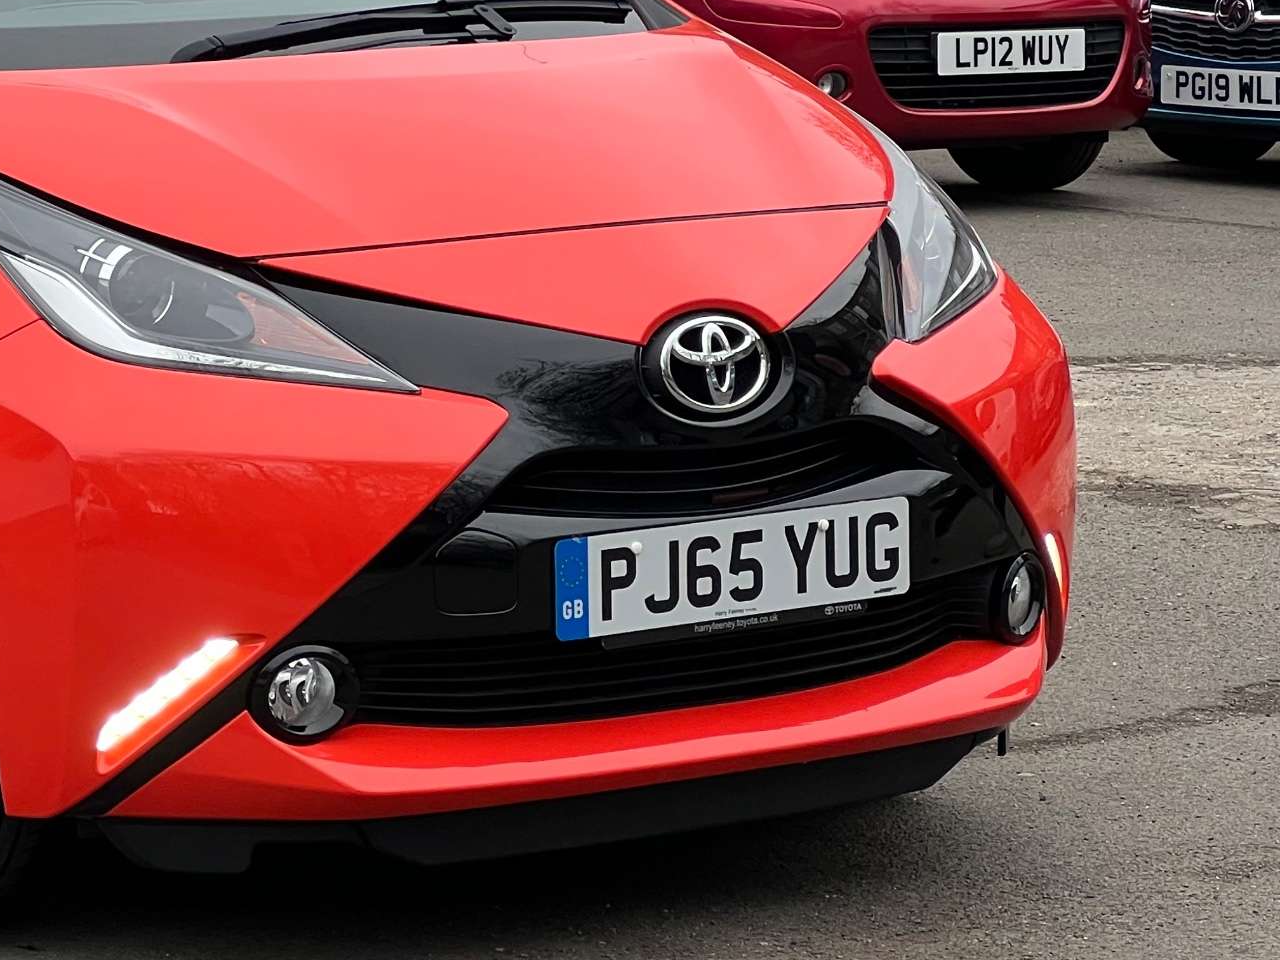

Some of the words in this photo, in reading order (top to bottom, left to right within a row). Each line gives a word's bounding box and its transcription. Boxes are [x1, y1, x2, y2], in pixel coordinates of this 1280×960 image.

[955, 37, 1014, 69] LP12
[1021, 34, 1070, 66] WUY
[1176, 71, 1230, 102] PG19
[1239, 74, 1280, 105] WL
[600, 529, 764, 622] PJ65
[785, 511, 900, 595] YUG
[562, 599, 584, 620] GB
[835, 603, 862, 614] TOYOTA
